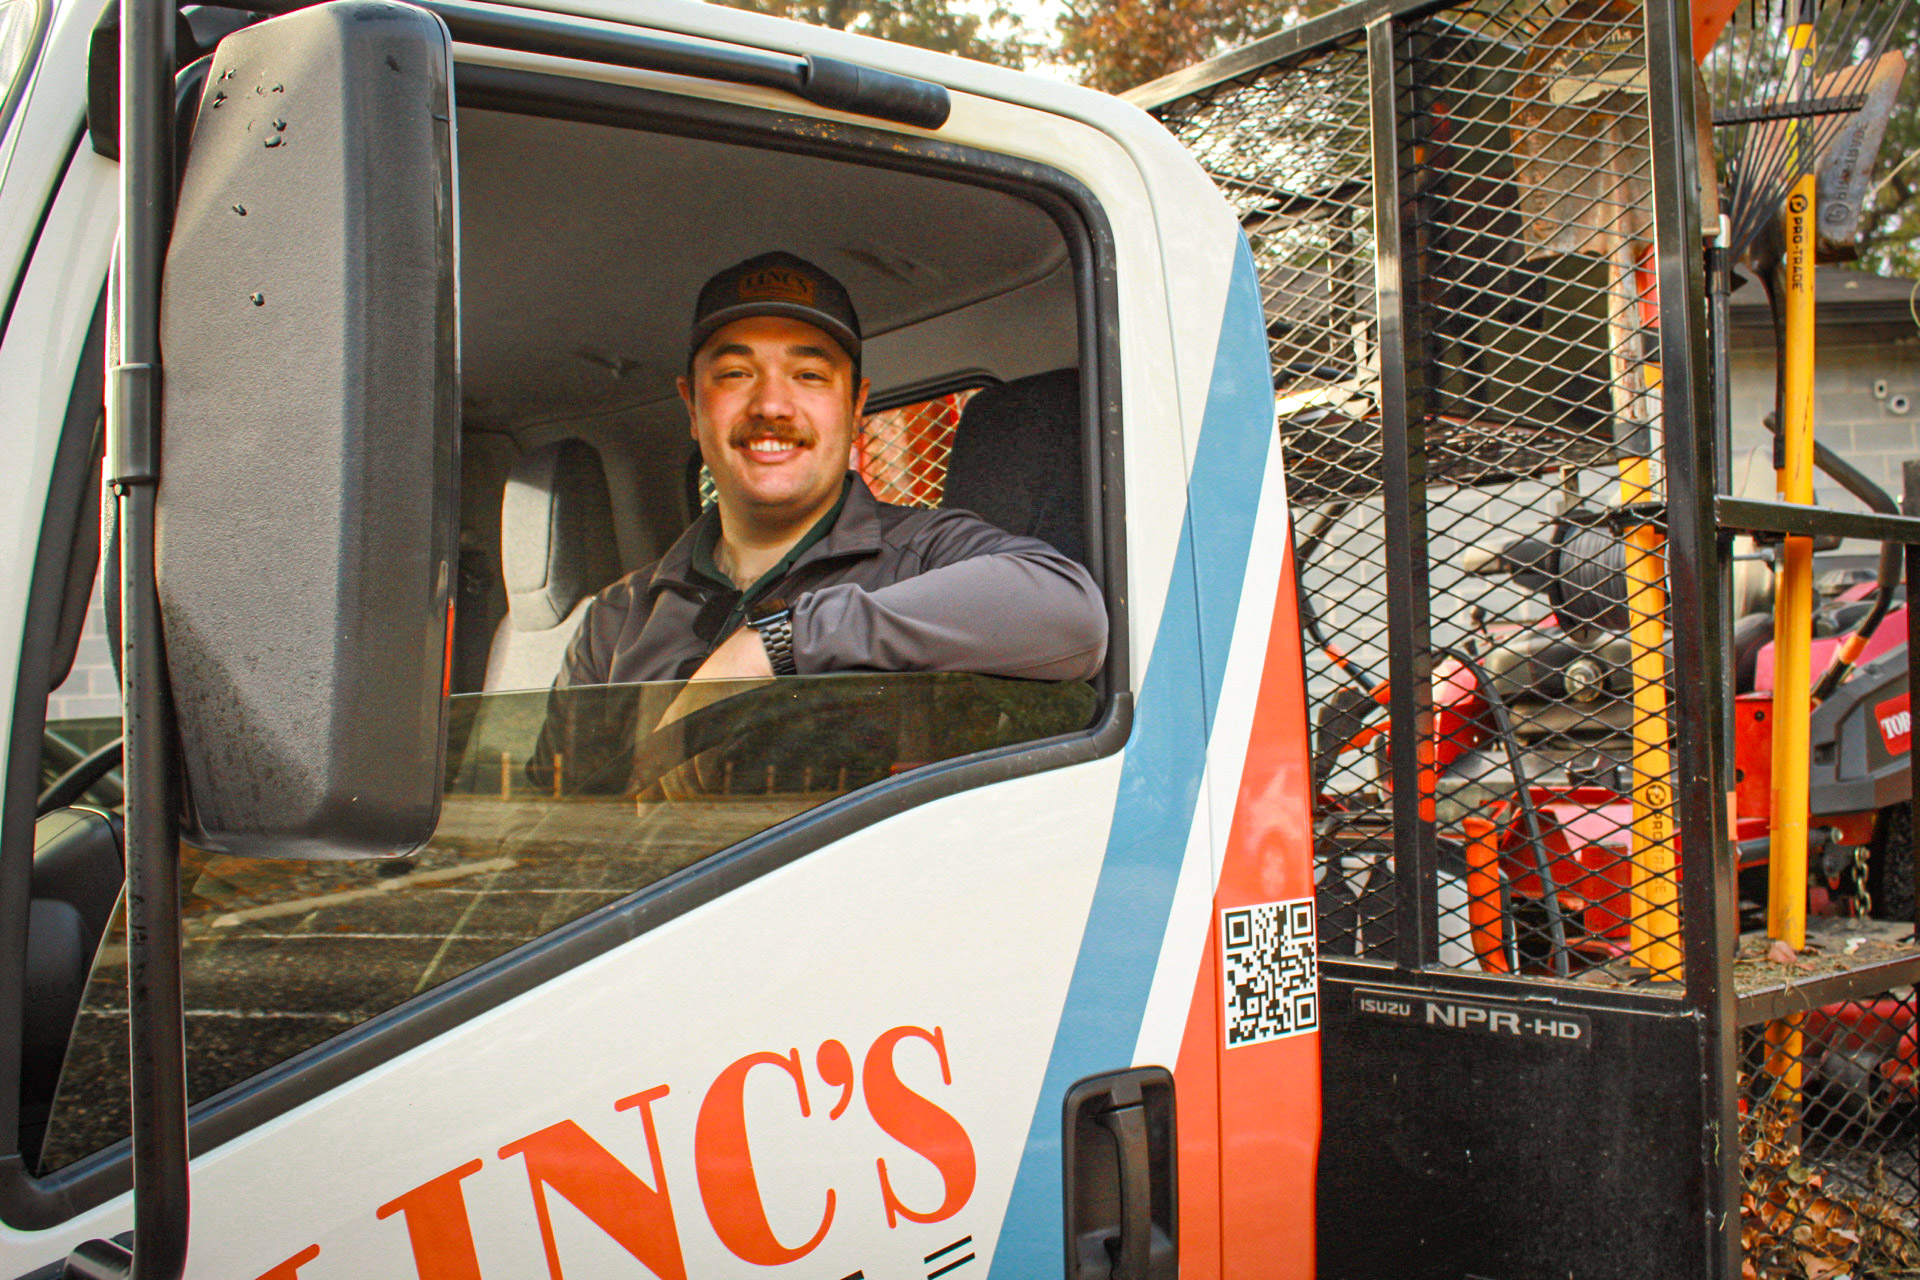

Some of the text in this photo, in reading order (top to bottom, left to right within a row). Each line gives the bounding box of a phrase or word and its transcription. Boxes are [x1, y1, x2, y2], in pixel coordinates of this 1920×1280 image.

[1792, 216, 1804, 291] PRO-TRADE
[1880, 711, 1911, 739] TOR
[1652, 811, 1667, 893] PROTRADE
[1360, 999, 1411, 1017] ISUZU
